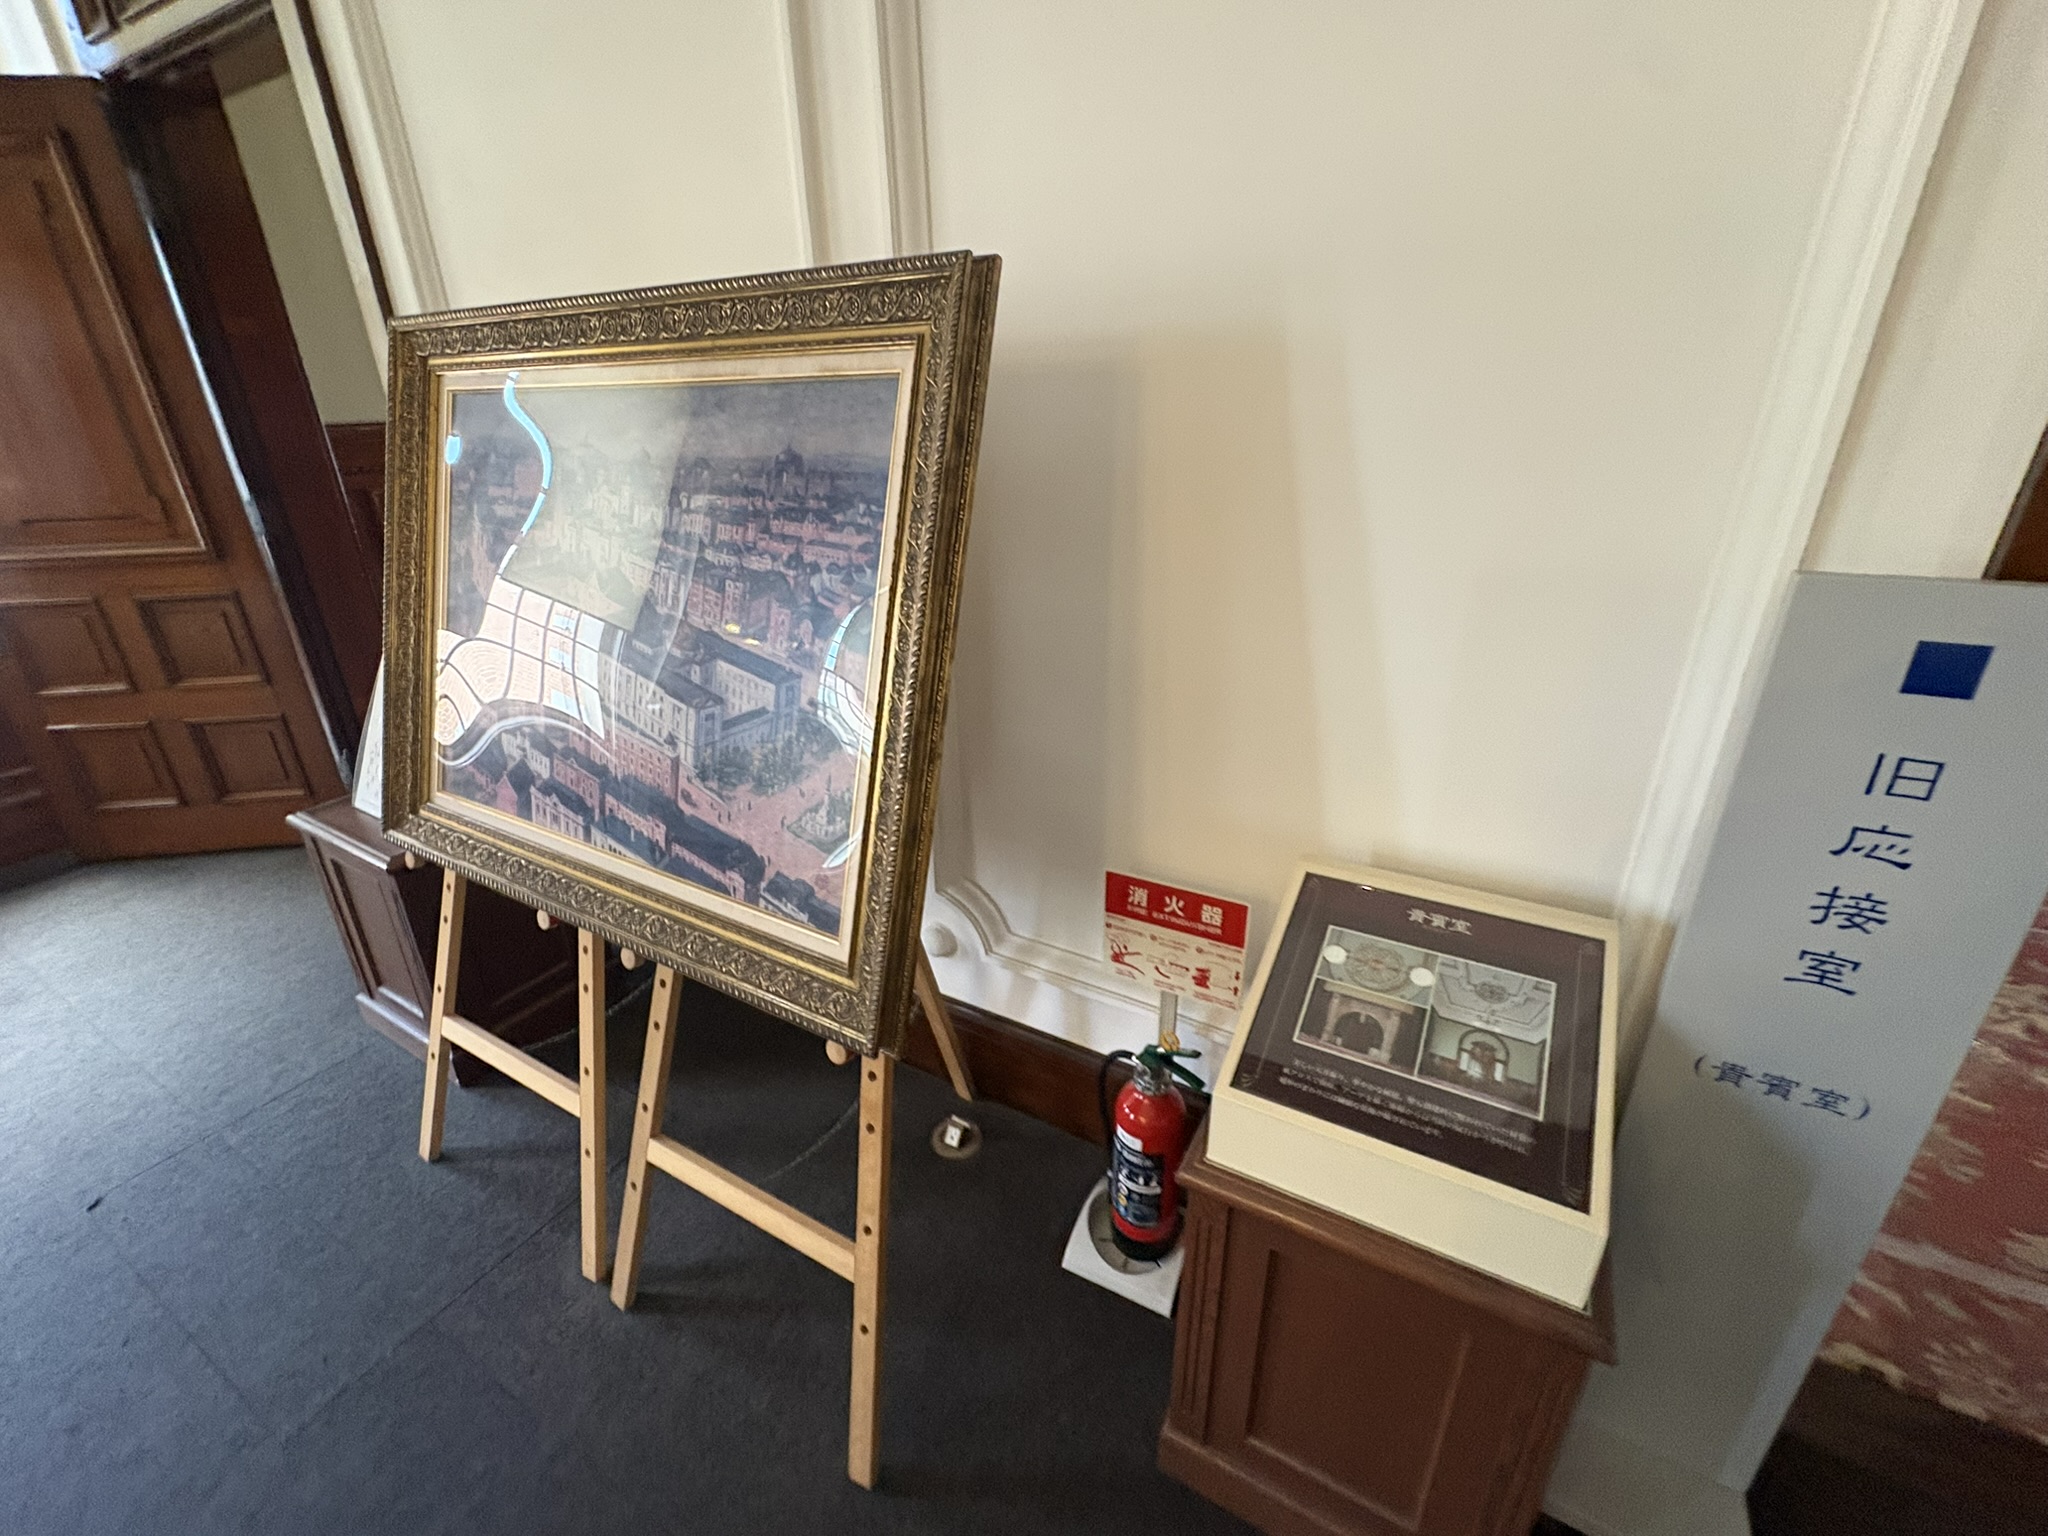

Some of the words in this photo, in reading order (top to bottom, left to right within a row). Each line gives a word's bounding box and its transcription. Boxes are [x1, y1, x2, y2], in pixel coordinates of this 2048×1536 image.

[1784, 752, 1946, 996] 旧応接室
[1127, 885, 1223, 926] 消火器
[1405, 907, 1472, 936] 貴賓室
